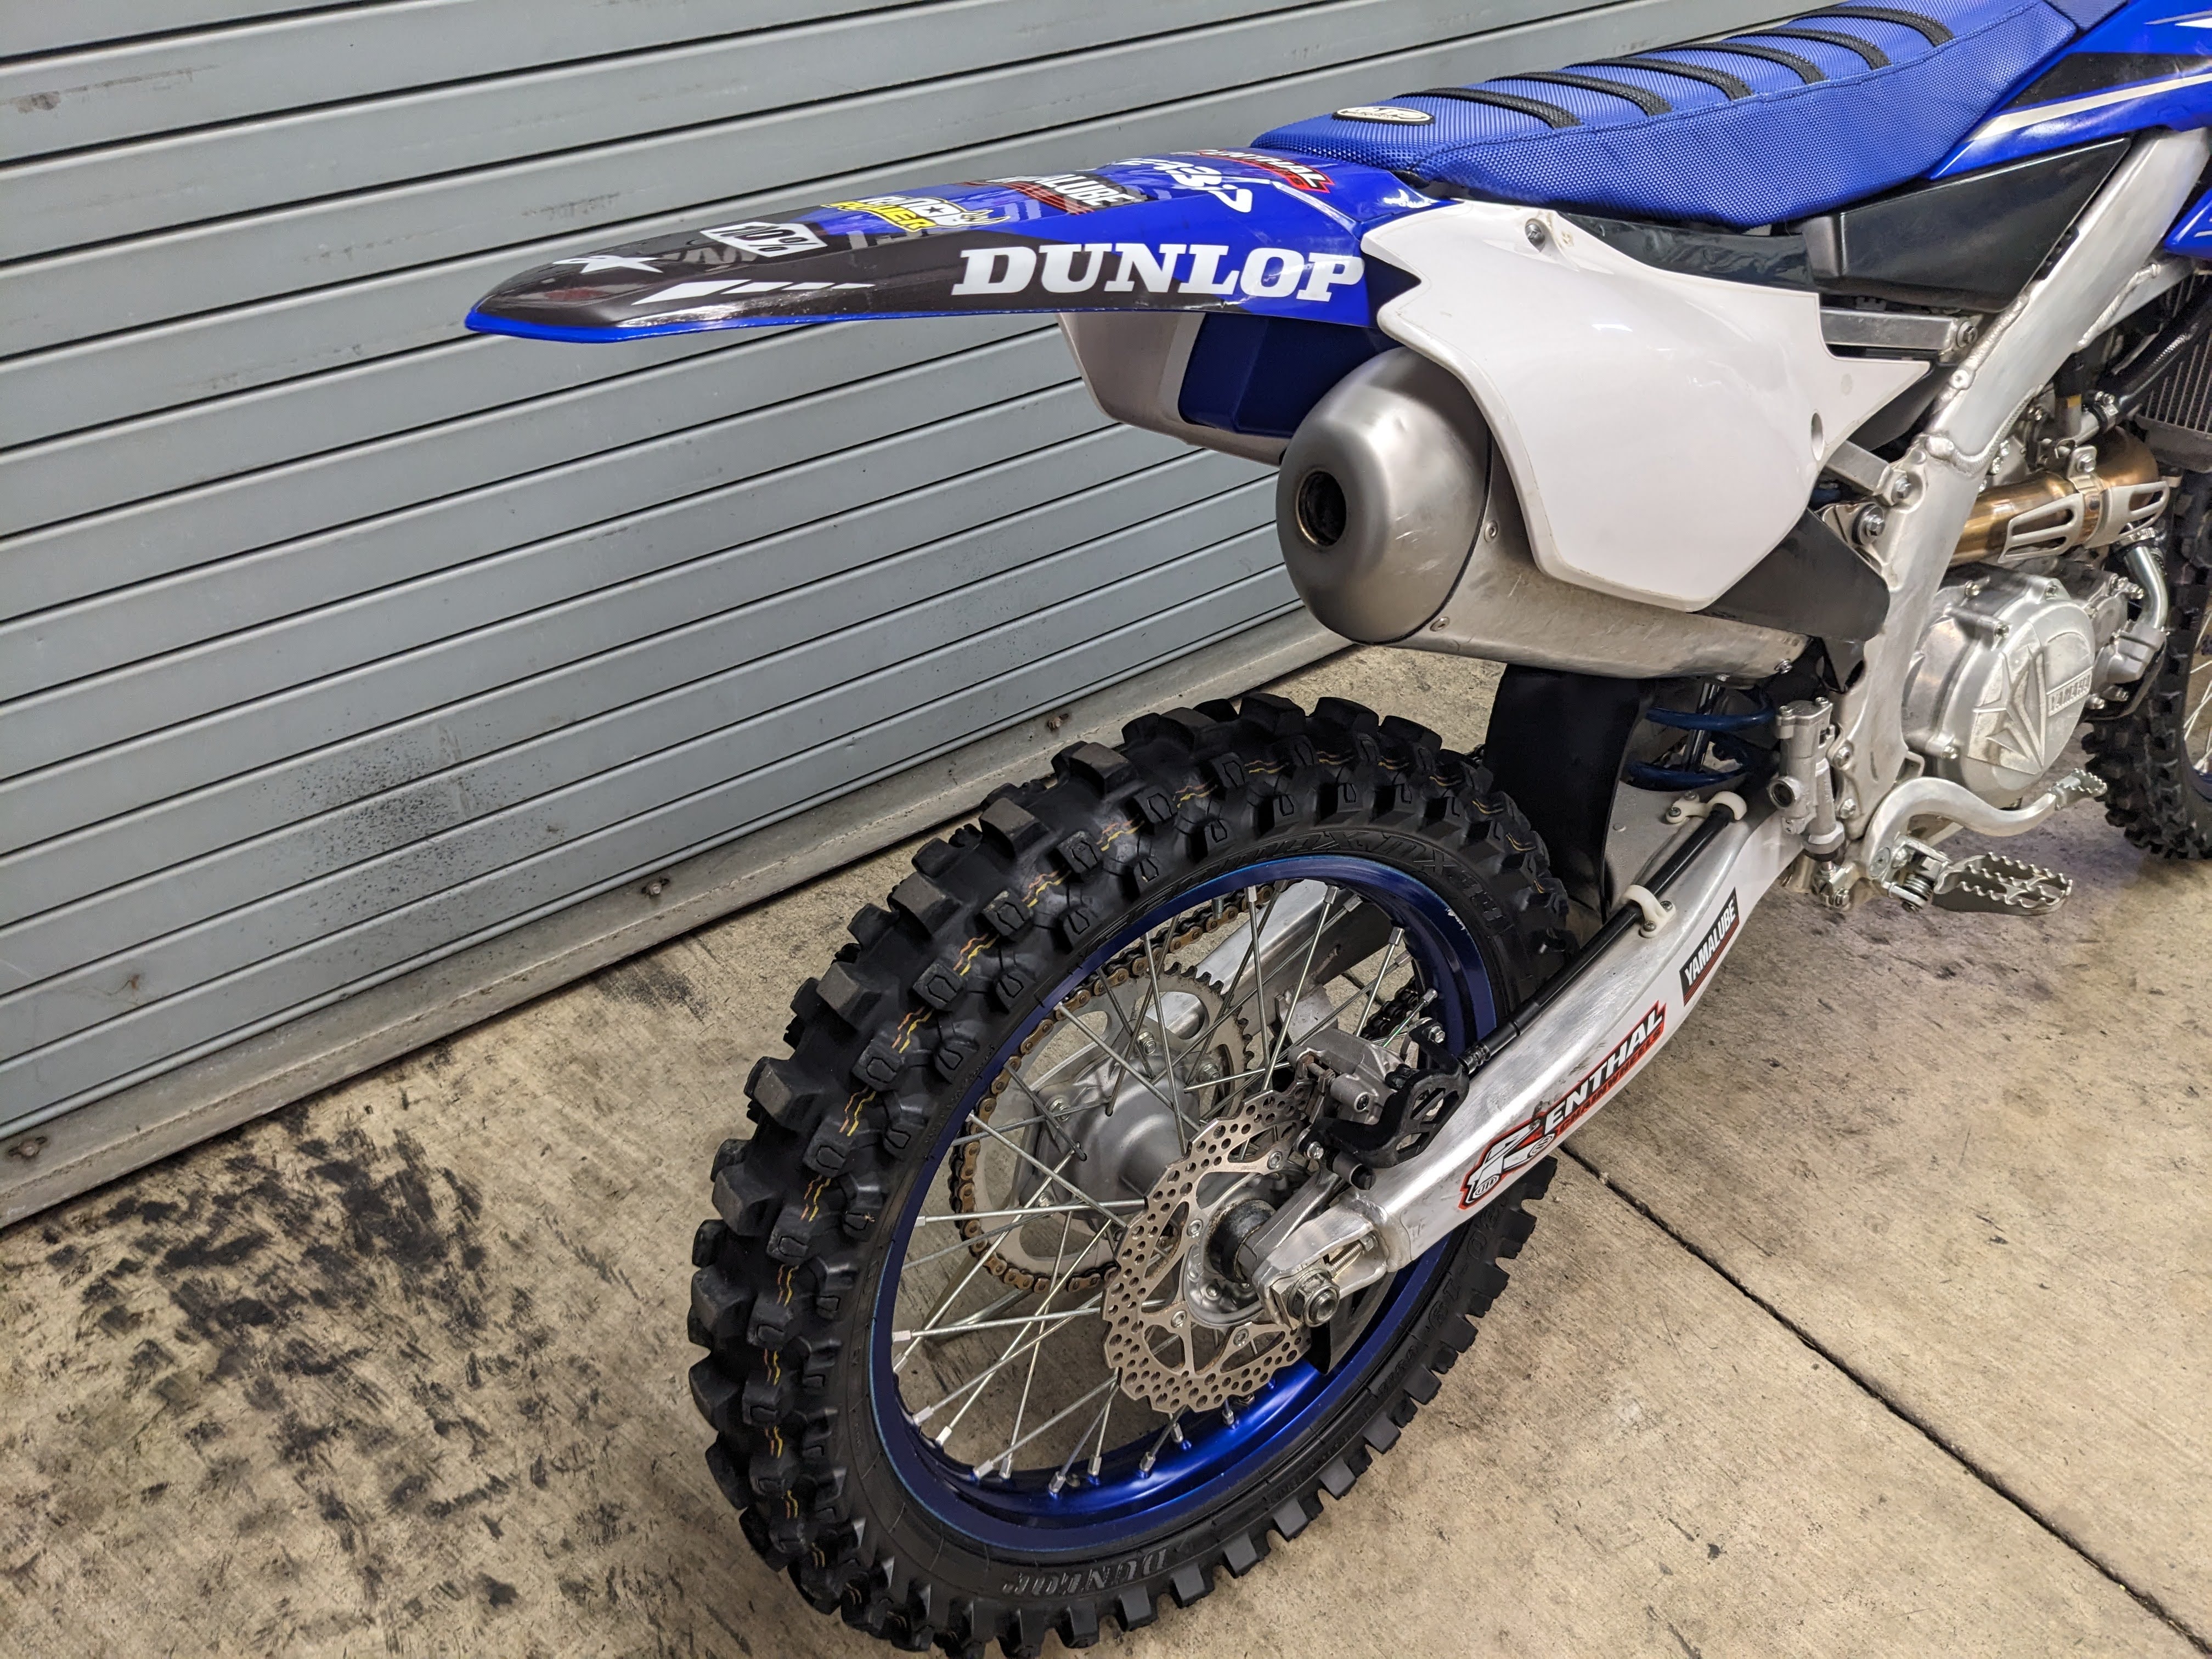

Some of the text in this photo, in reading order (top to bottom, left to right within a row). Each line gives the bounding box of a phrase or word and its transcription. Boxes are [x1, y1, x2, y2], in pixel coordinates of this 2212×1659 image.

[951, 242, 1365, 301] DUNLOP
[1685, 899, 1736, 986] YAMALUBE
[1466, 1009, 1662, 1204] RENTHAL
[1002, 1548, 1167, 1596] DUNLOP
